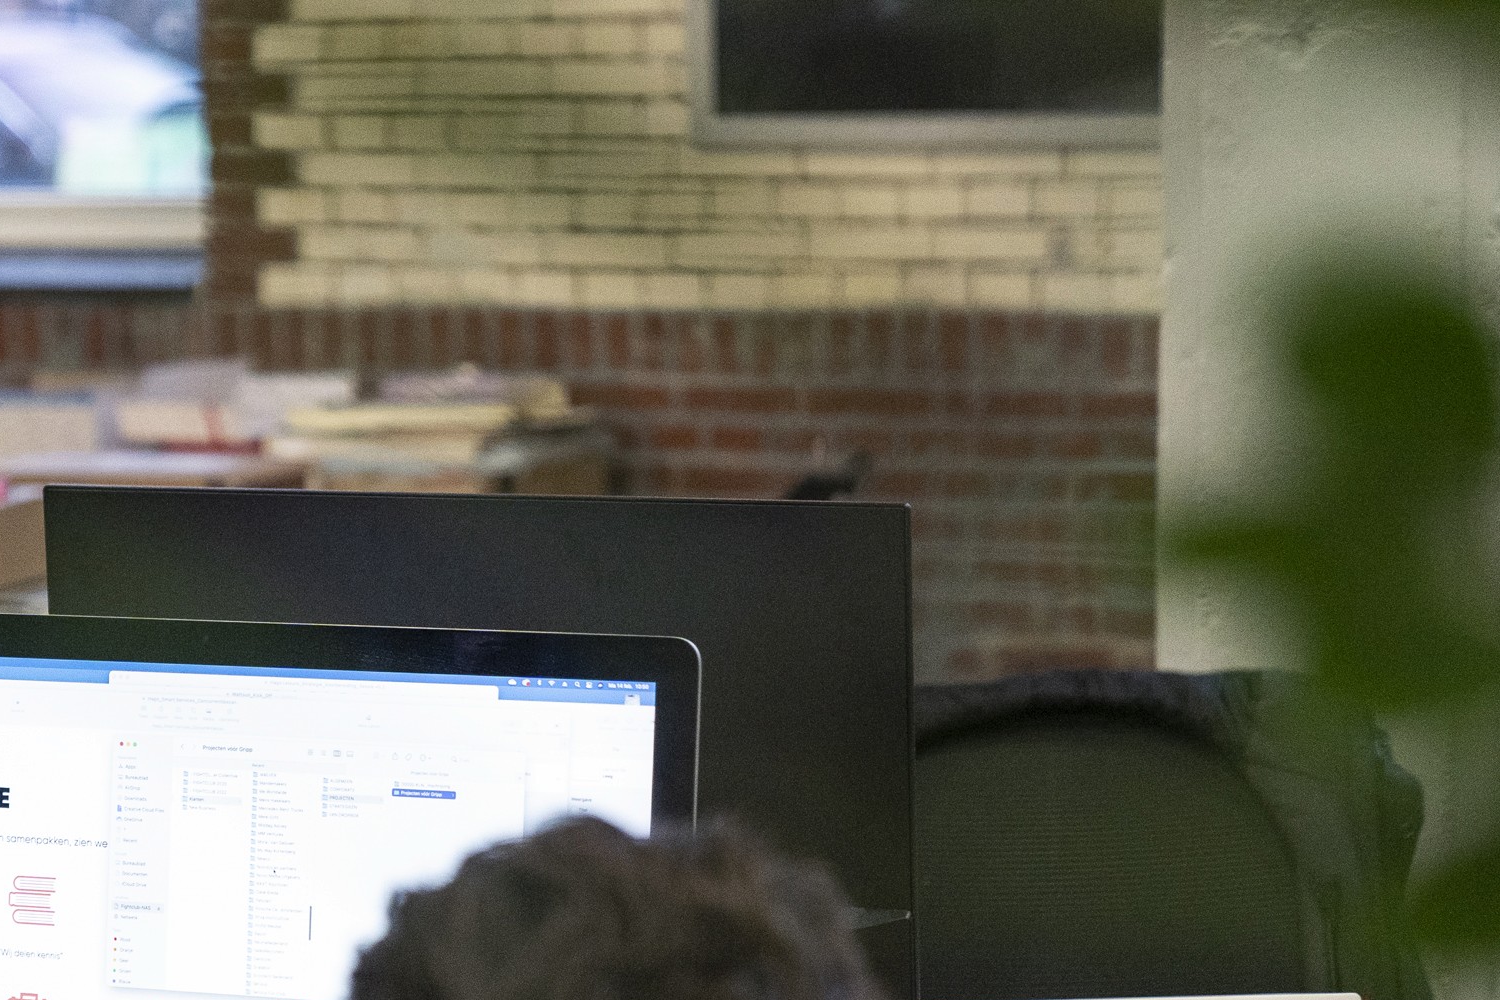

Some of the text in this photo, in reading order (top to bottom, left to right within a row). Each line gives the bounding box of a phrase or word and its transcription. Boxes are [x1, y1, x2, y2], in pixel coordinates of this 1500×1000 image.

[202, 744, 226, 752] Projecten
[6, 834, 72, 847] samenpakken,
[74, 836, 93, 847] zien
[94, 839, 109, 849] we
[13, 949, 35, 960] delen
